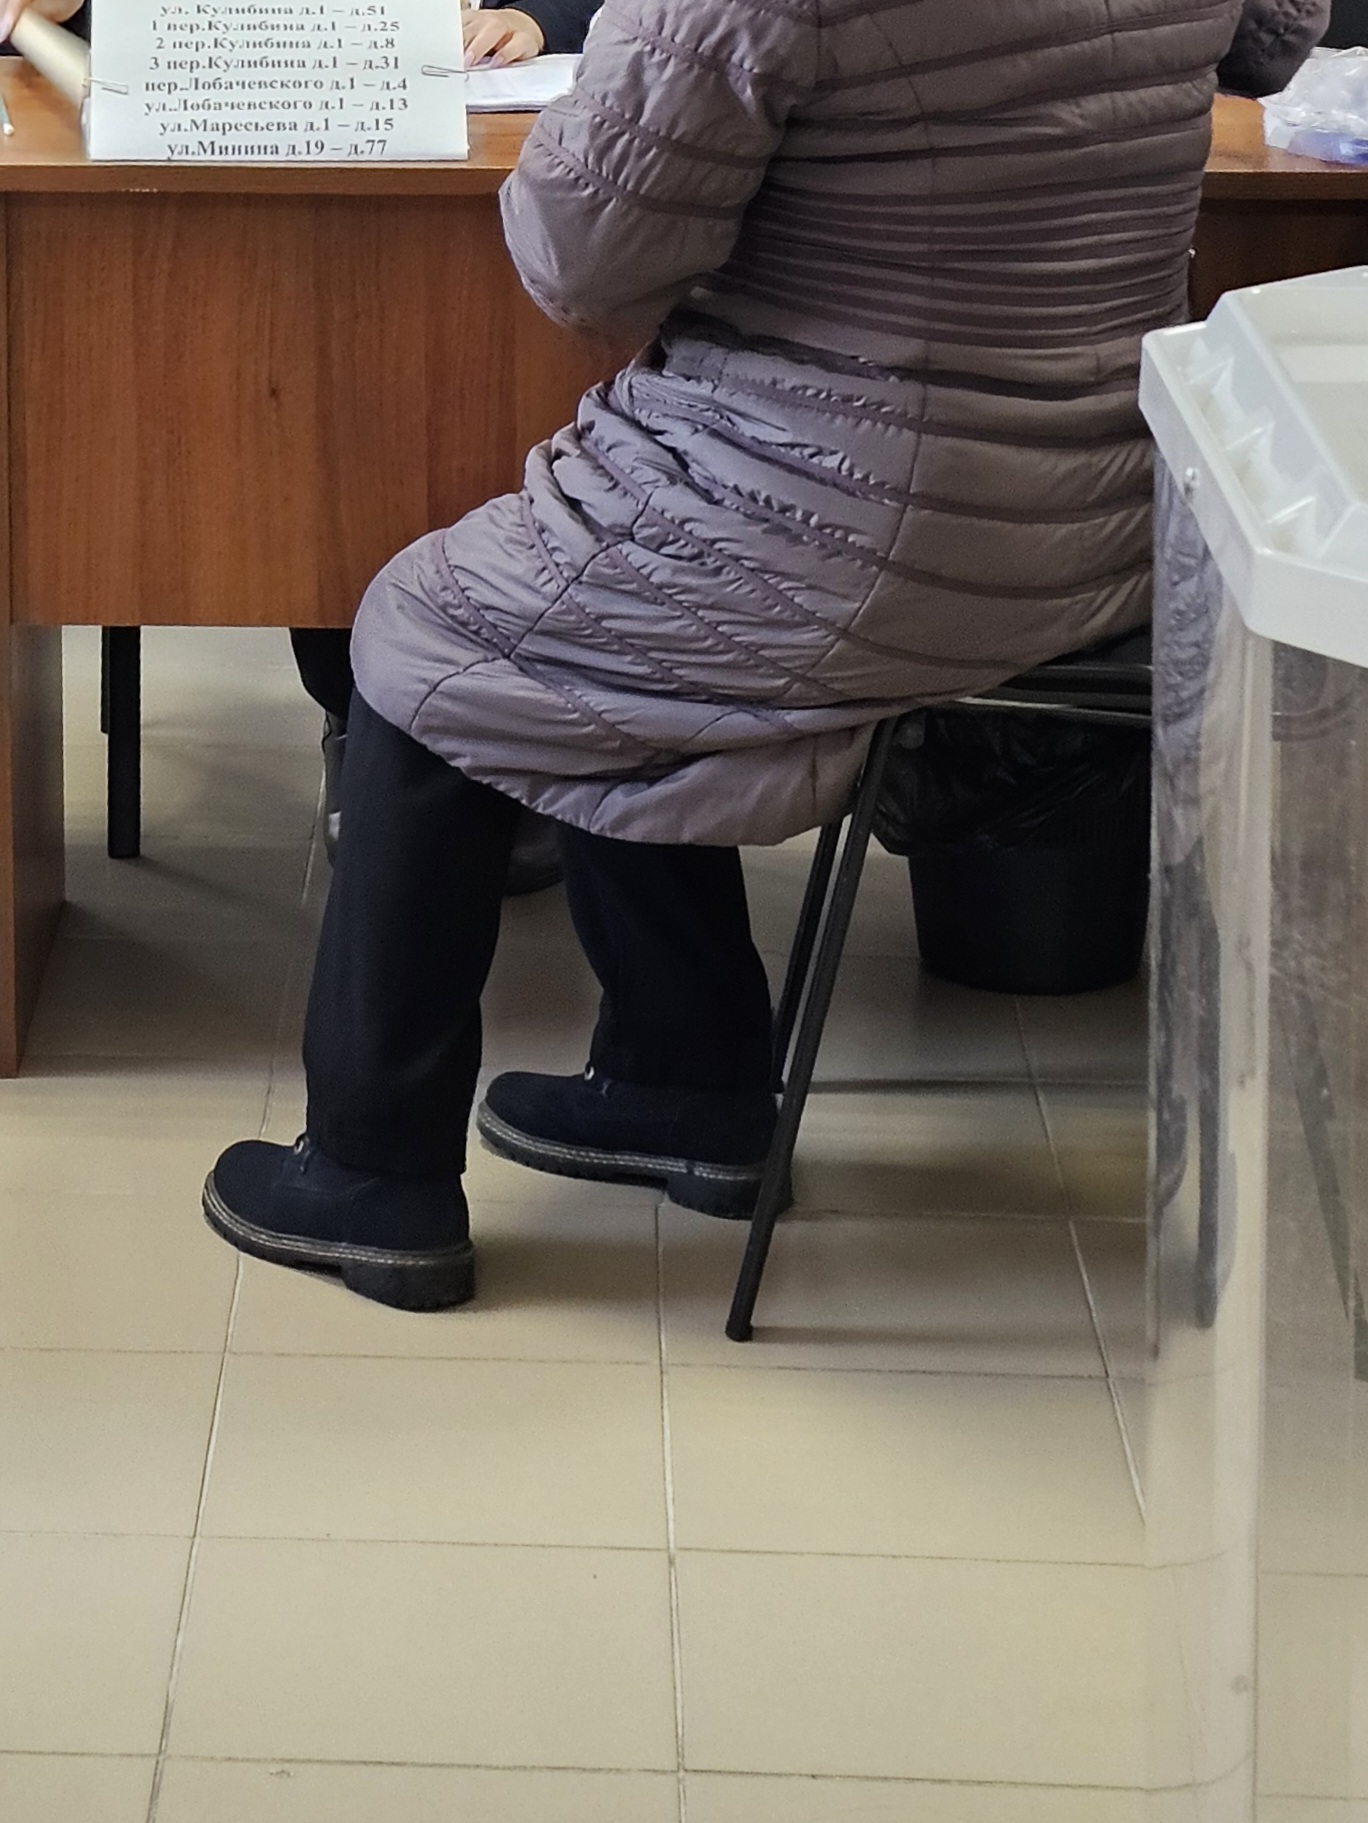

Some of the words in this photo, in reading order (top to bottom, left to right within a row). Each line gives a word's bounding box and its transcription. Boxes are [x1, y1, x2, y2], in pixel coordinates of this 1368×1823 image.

[160, 6, 189, 17] ул.
[196, 4, 293, 17] Кулибина
[299, 5, 324, 16] д.1
[350, 5, 385, 16] д.51
[152, 20, 157, 31] 1
[167, 20, 305, 34] пер.Кулибина
[311, 21, 336, 32] д.1
[362, 21, 400, 32] д.25
[156, 37, 165, 49] 2
[172, 37, 311, 52] пер.Кулибина
[317, 38, 342, 50] д.1
[368, 38, 395, 50] д.8
[149, 56, 159, 70] 3
[167, 56, 306, 73] пер.Кулибина
[312, 56, 337, 70] д.1
[330, 77, 355, 91] д.1
[380, 77, 408, 91] д.4
[319, 97, 344, 111] д.1
[370, 98, 408, 111] д.13
[159, 118, 297, 136] ул.Маресьева
[304, 118, 330, 132] д.1
[354, 118, 394, 132] д.15
[167, 140, 279, 159] ул.Минина
[285, 139, 325, 157] д.19
[347, 139, 387, 157] д.77
